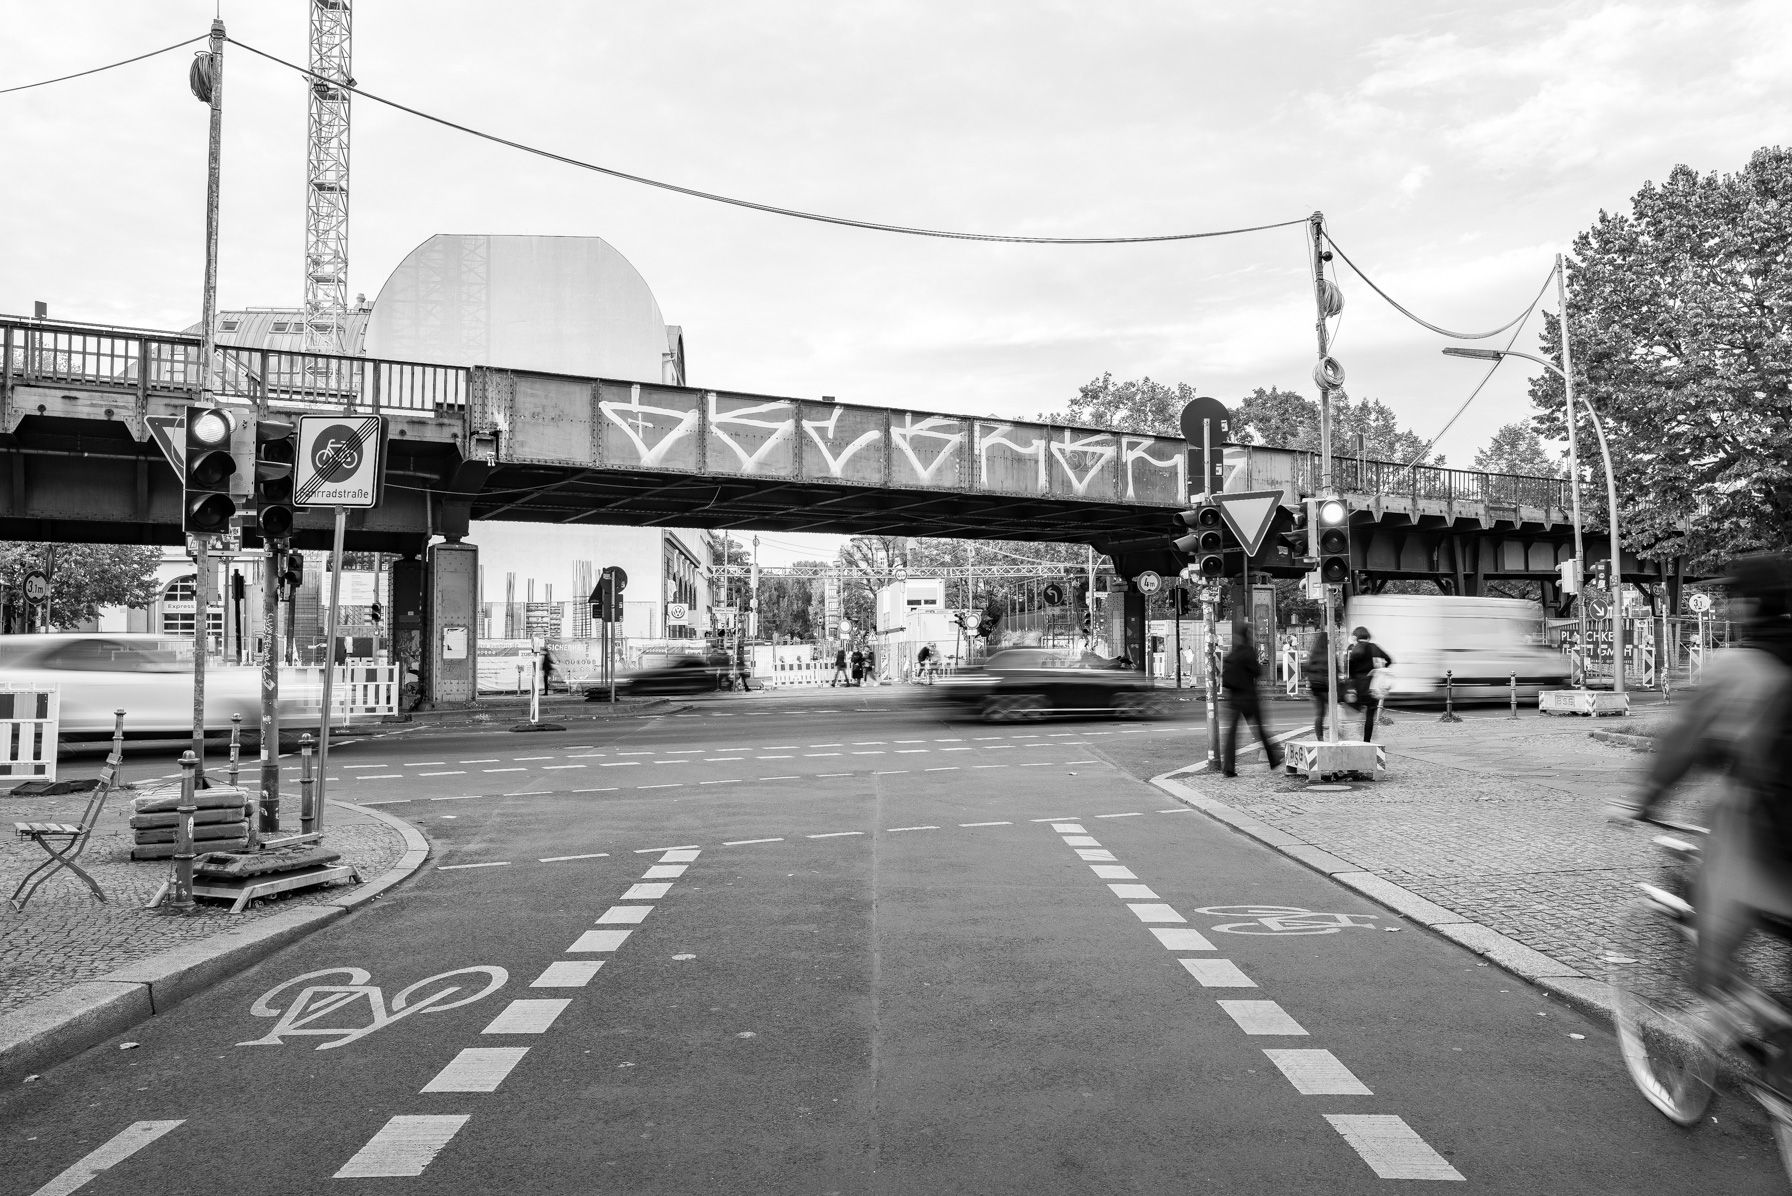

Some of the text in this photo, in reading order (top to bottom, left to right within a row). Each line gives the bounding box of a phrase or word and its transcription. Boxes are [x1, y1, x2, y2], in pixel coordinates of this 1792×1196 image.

[302, 488, 369, 499] rradstraße
[1143, 577, 1156, 588] 4m
[1561, 631, 1614, 641] PLCHKE
[1290, 745, 1303, 766] BSG
